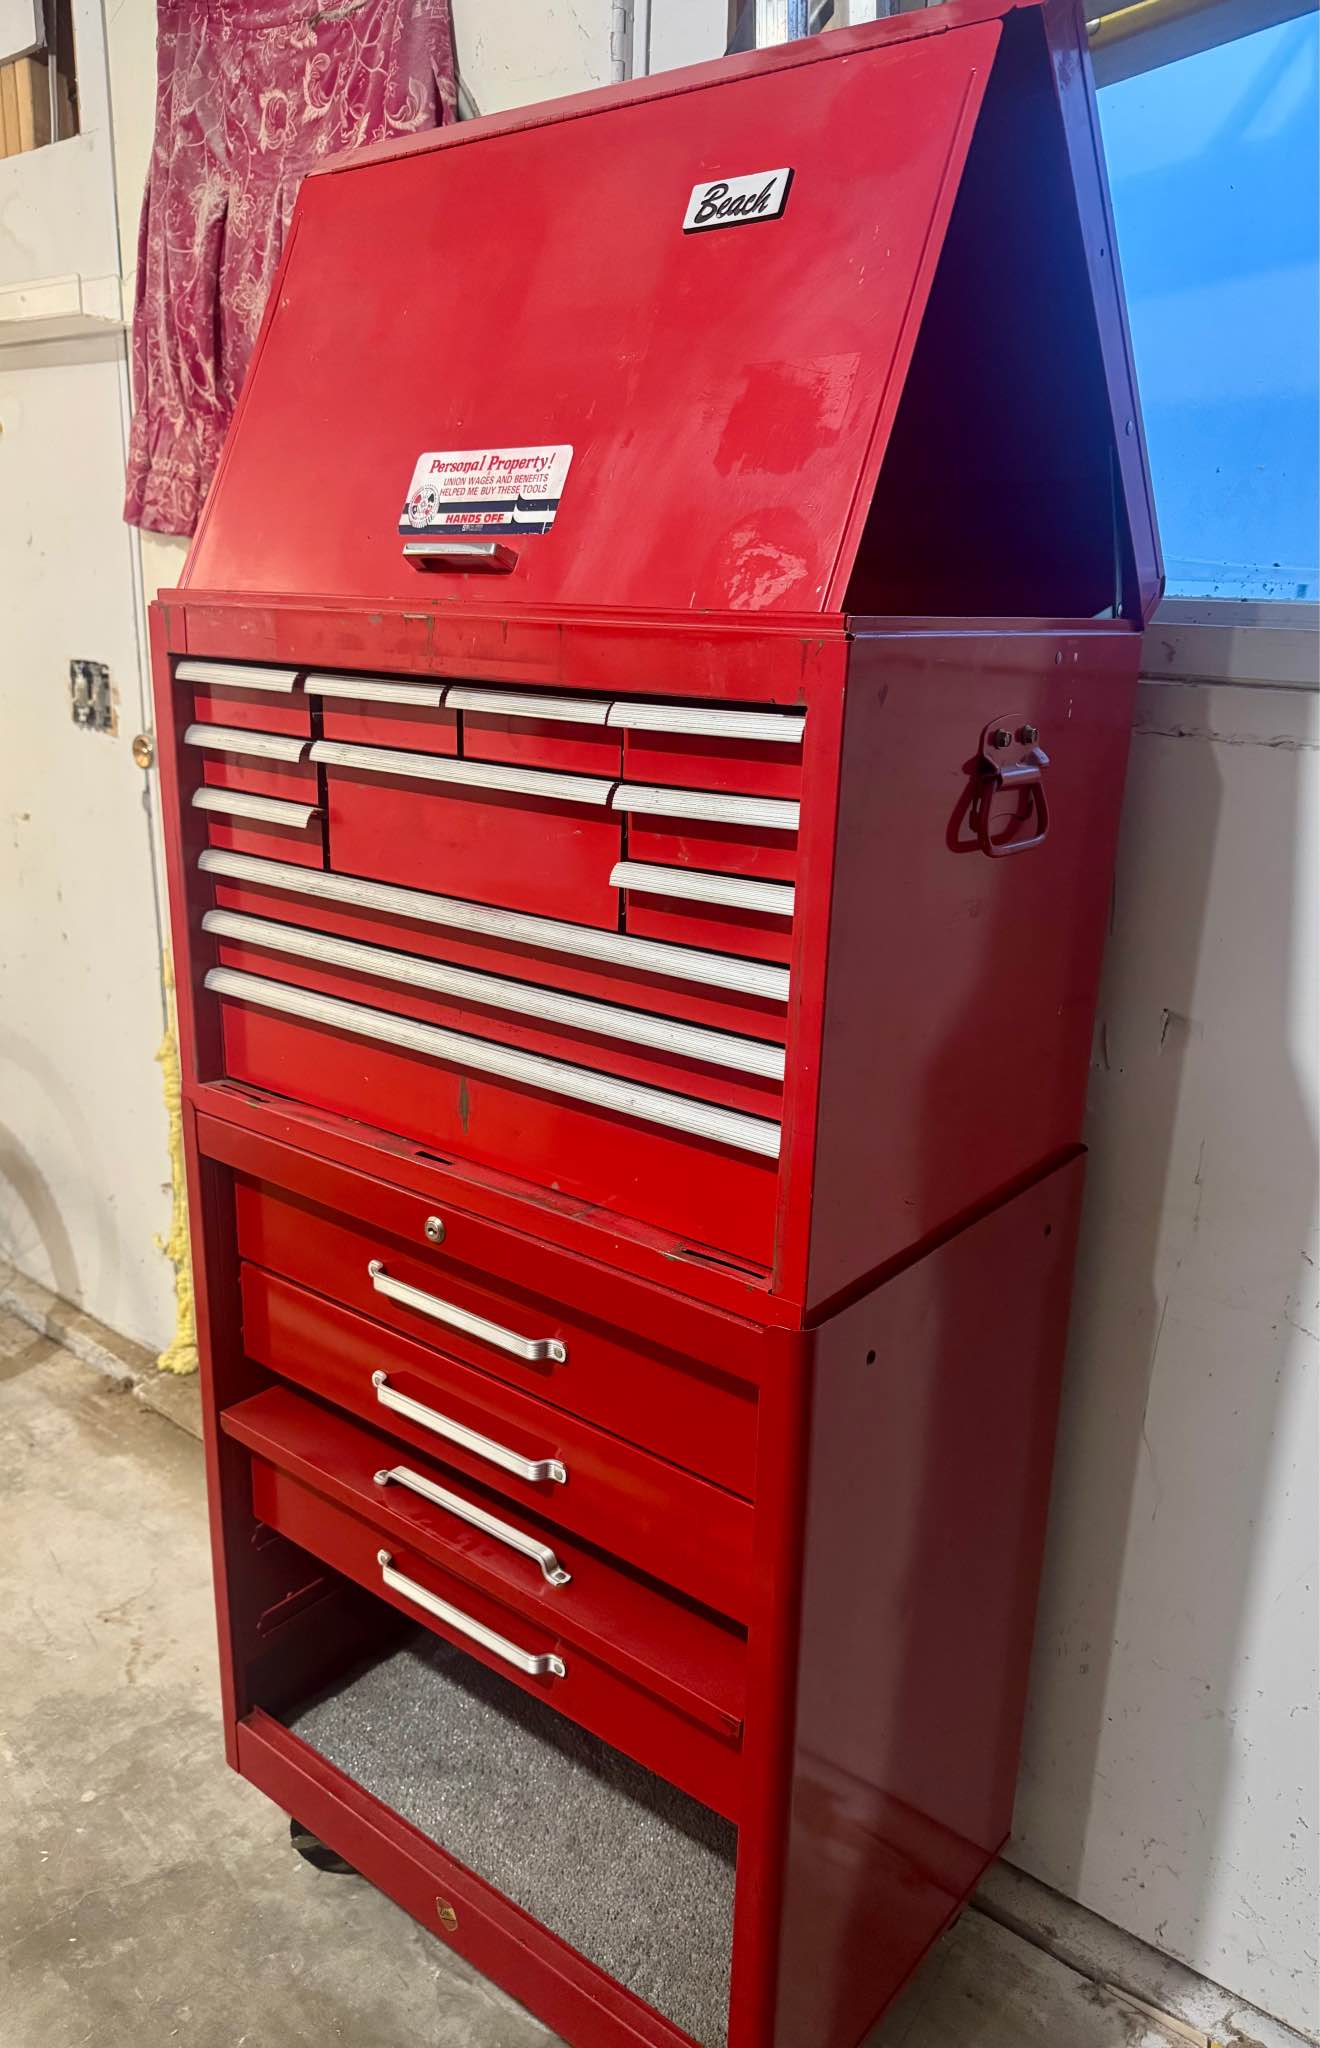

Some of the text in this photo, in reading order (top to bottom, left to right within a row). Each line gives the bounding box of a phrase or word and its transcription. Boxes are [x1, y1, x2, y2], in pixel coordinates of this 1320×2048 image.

[693, 177, 778, 224] Beach
[428, 452, 557, 475] Personal Property!
[443, 473, 549, 486] UNION WAGES AND BENEFITS
[439, 483, 548, 497] HELPED ME BUY THESE TOOLS
[445, 513, 505, 524] HANDS OFF
